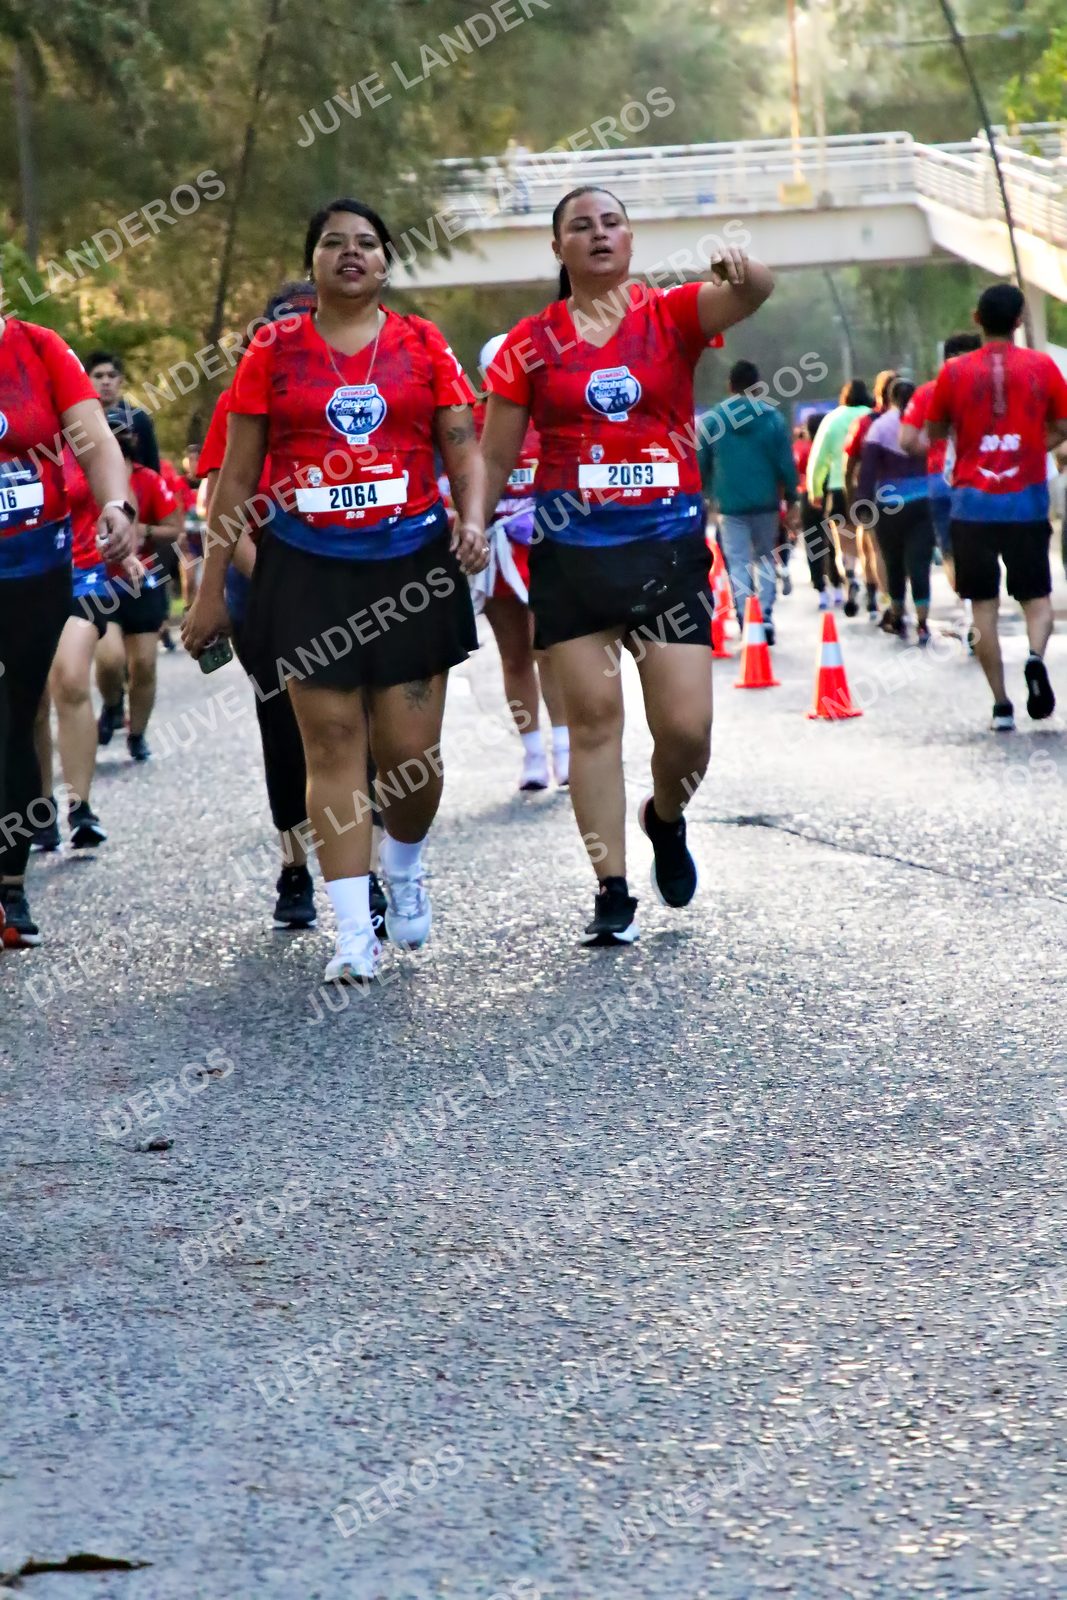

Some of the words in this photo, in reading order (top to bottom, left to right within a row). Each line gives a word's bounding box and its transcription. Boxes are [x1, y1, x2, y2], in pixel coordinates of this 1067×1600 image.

[598, 379, 626, 389] Global
[341, 398, 371, 408] Global
[608, 465, 653, 485] 2063
[330, 484, 378, 509] 2064
